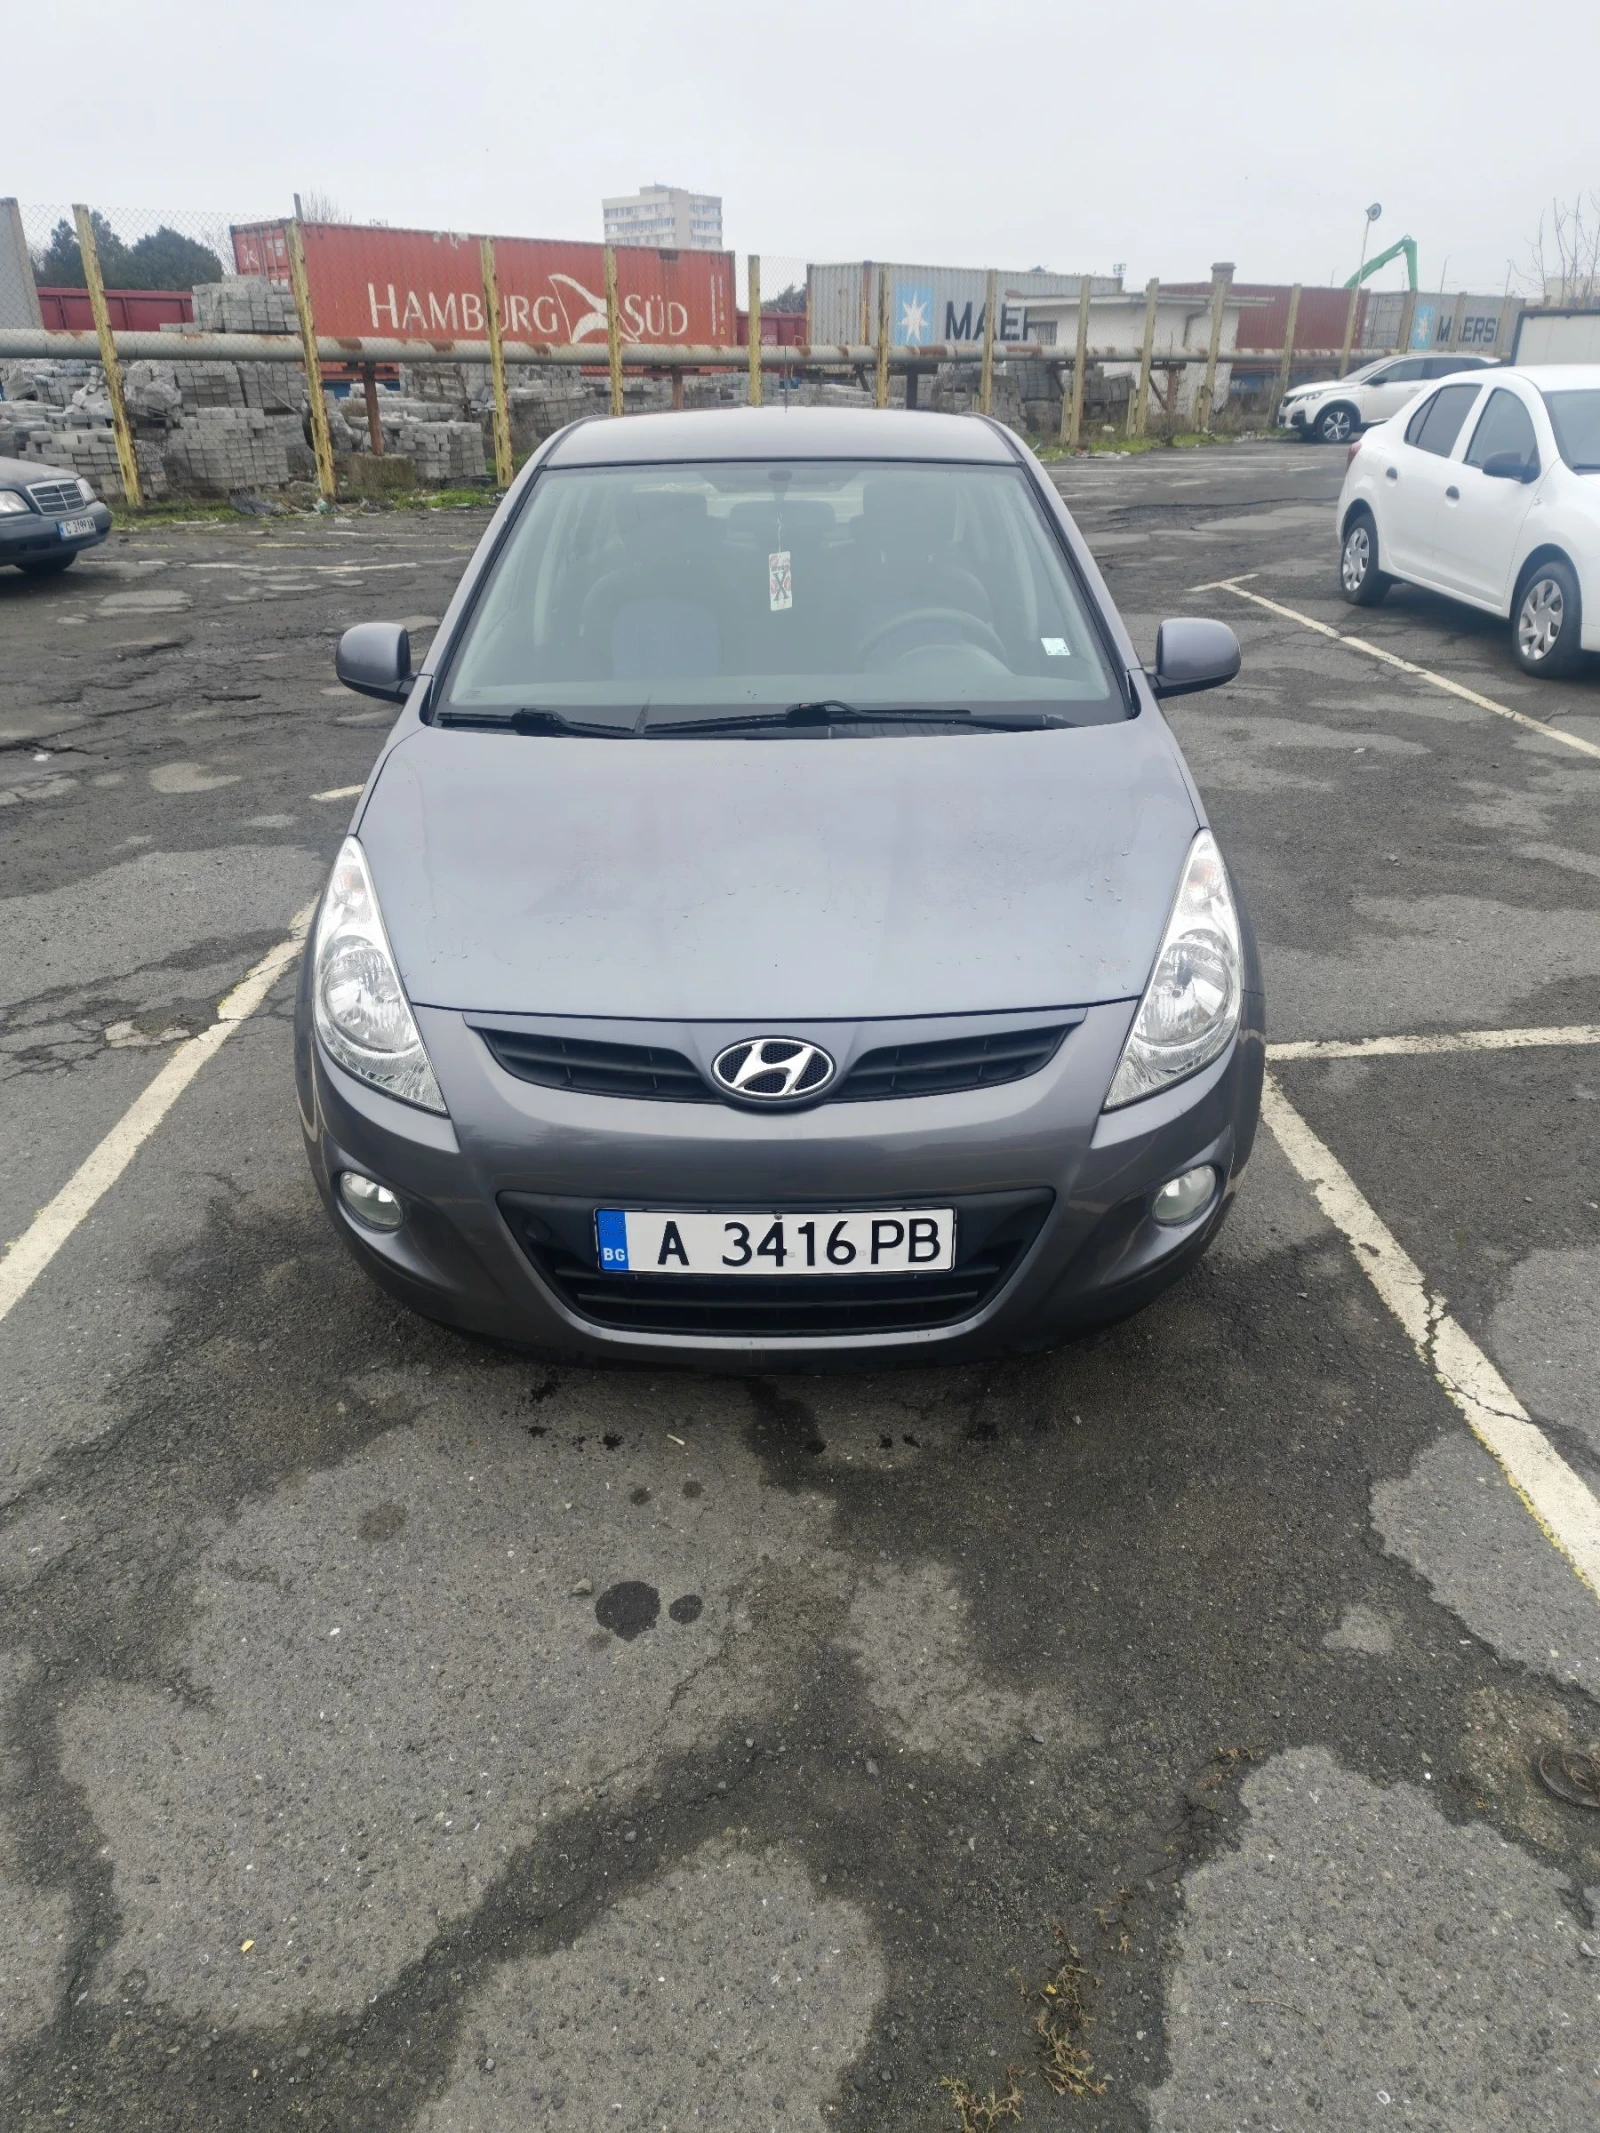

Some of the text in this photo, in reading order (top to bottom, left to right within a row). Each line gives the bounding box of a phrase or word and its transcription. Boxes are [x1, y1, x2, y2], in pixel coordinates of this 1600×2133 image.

[624, 294, 688, 336] SÜD
[1436, 315, 1500, 343] MERS
[603, 1247, 626, 1262] BG
[657, 1220, 690, 1266] A
